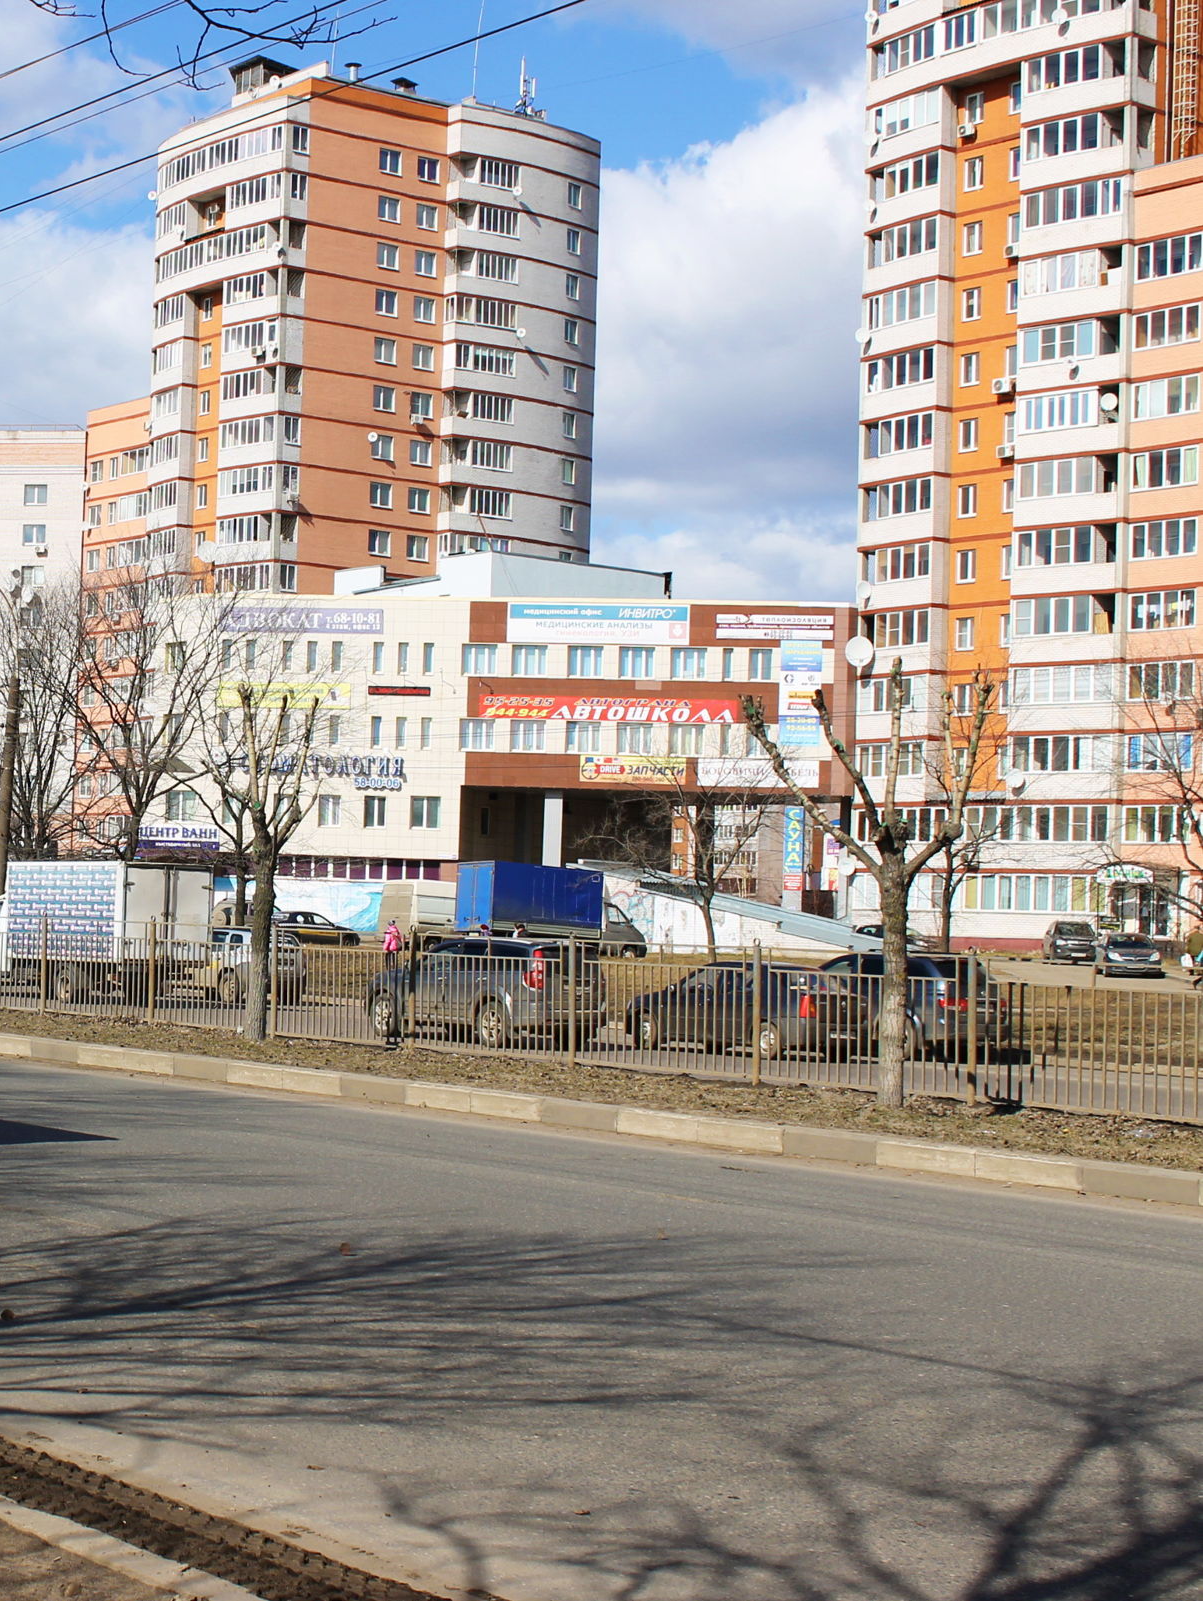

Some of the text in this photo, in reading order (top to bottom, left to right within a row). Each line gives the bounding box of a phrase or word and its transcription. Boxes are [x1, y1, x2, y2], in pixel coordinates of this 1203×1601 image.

[580, 608, 603, 616] офис
[618, 608, 673, 619] ИНВИТРО
[536, 621, 653, 630] МЕДИЦИНСКИЕ АНАЛИЗЫ
[483, 696, 555, 706] 95-25-35
[550, 705, 734, 723] АВТОШКОЛА
[599, 765, 622, 774] DRIVE
[627, 765, 685, 776] ЗАПЧАСТИ
[354, 777, 399, 788] 58-00-06
[139, 826, 217, 839] ЦЕНТР ВАНН
[787, 809, 801, 862] САУНА
